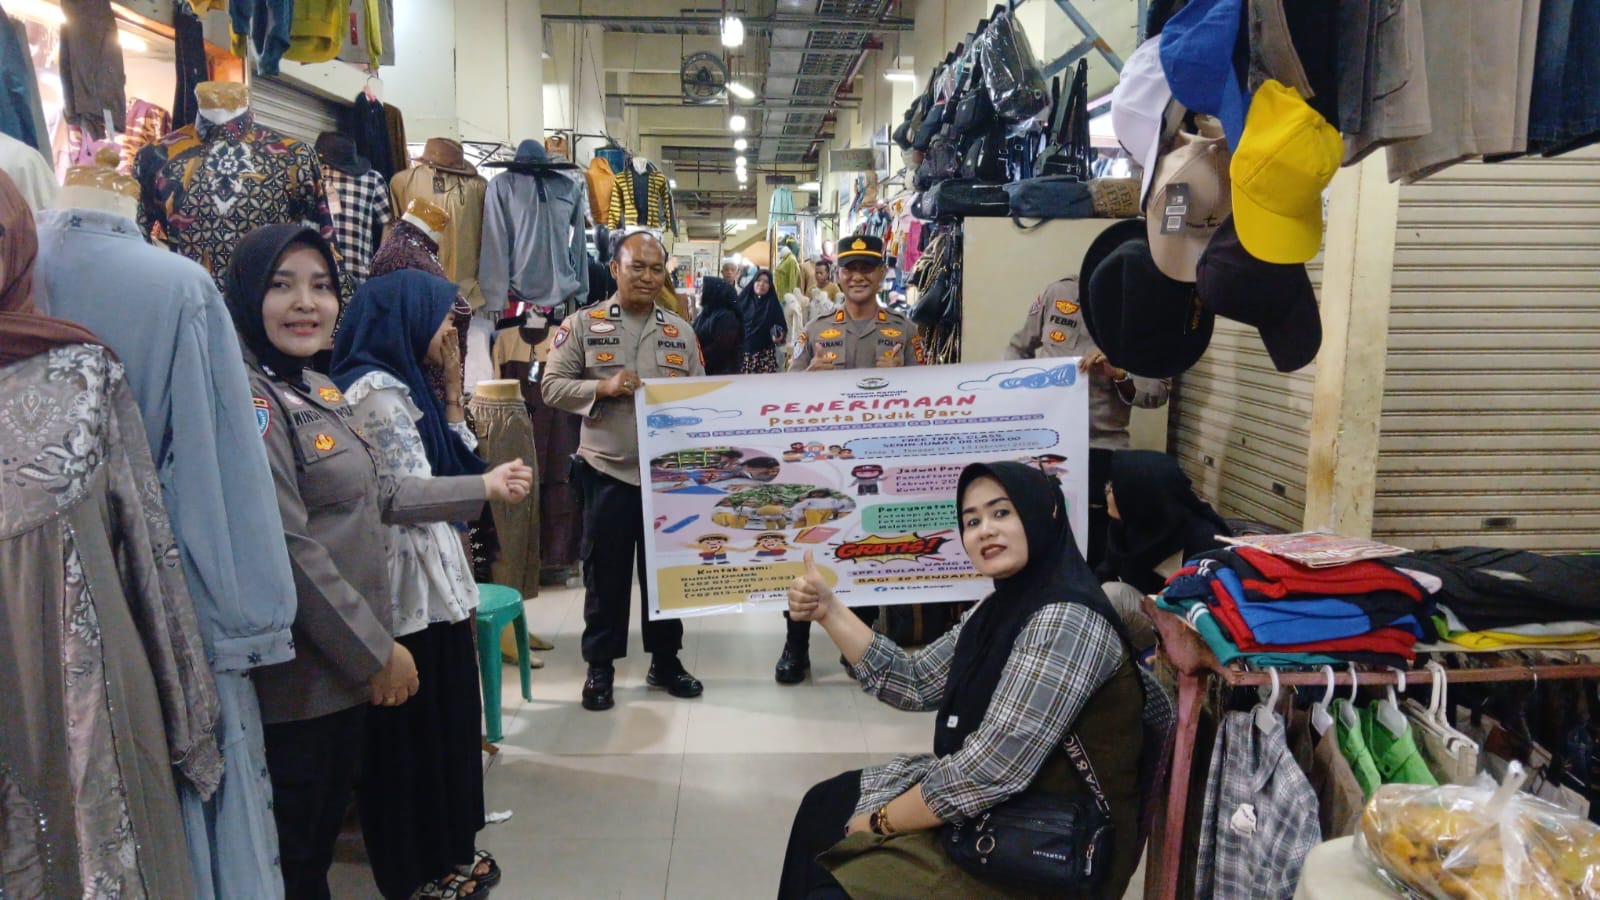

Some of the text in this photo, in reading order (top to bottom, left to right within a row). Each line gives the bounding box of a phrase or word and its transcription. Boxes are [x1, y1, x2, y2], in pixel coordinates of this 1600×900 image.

[1050, 314, 1077, 328] FEBRI
[658, 339, 686, 350] POLRI
[760, 394, 976, 416] PENERIMAAN
[769, 408, 973, 427] Peserta Didik Baru
[896, 467, 937, 475] Jadwal
[836, 537, 942, 558] GRATIS!
[697, 567, 739, 575] Kontak
